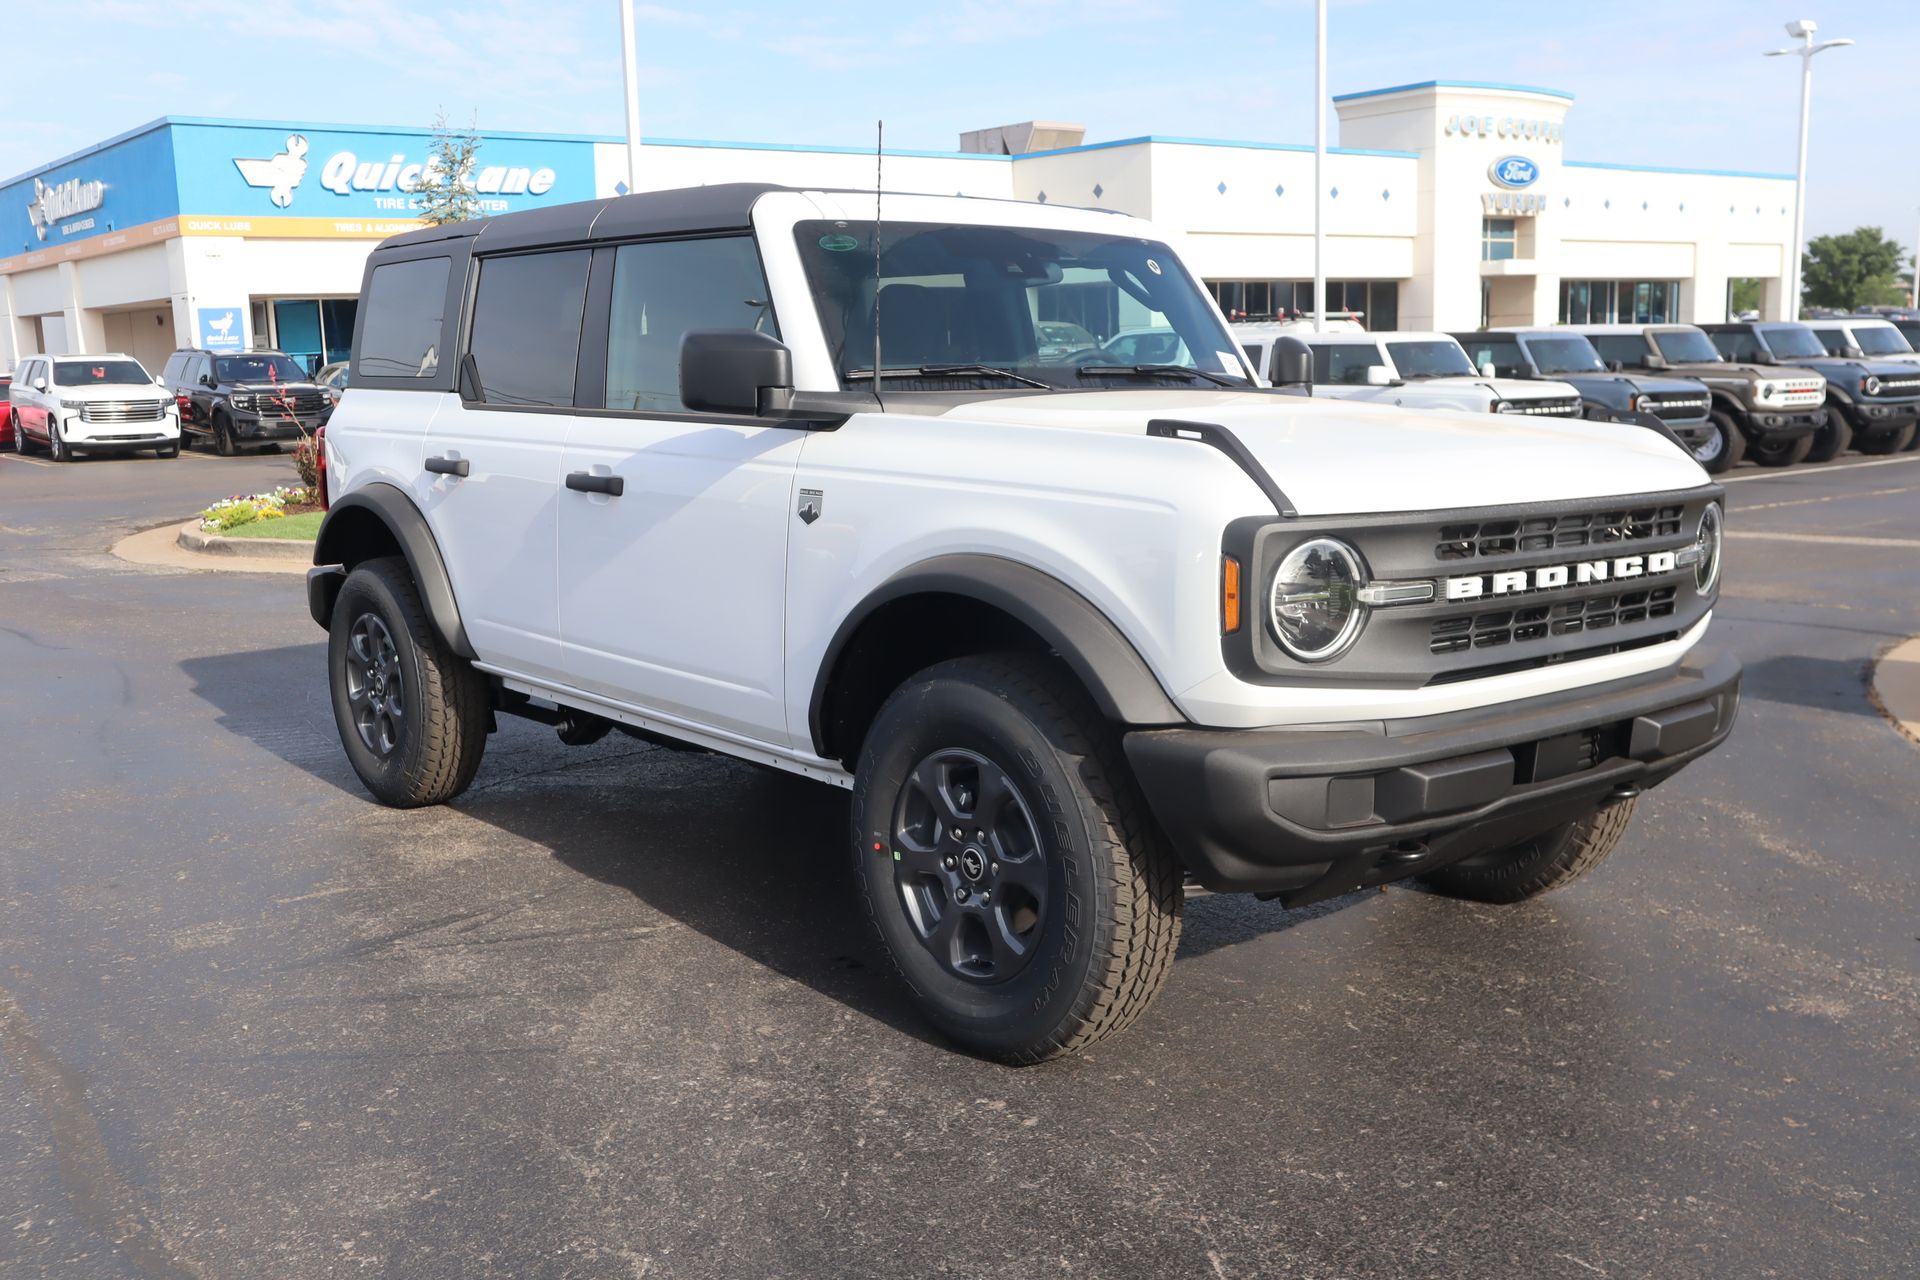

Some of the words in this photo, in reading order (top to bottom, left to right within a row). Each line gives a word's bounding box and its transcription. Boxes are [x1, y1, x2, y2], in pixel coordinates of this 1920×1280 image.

[1446, 114, 1494, 137] JOE
[1503, 160, 1533, 181] Ford
[374, 197, 404, 210] TIRE
[188, 220, 222, 231] QUICK
[223, 221, 252, 232] LUBE
[335, 223, 362, 233] TIRES
[1445, 551, 1675, 599] BRONCO
